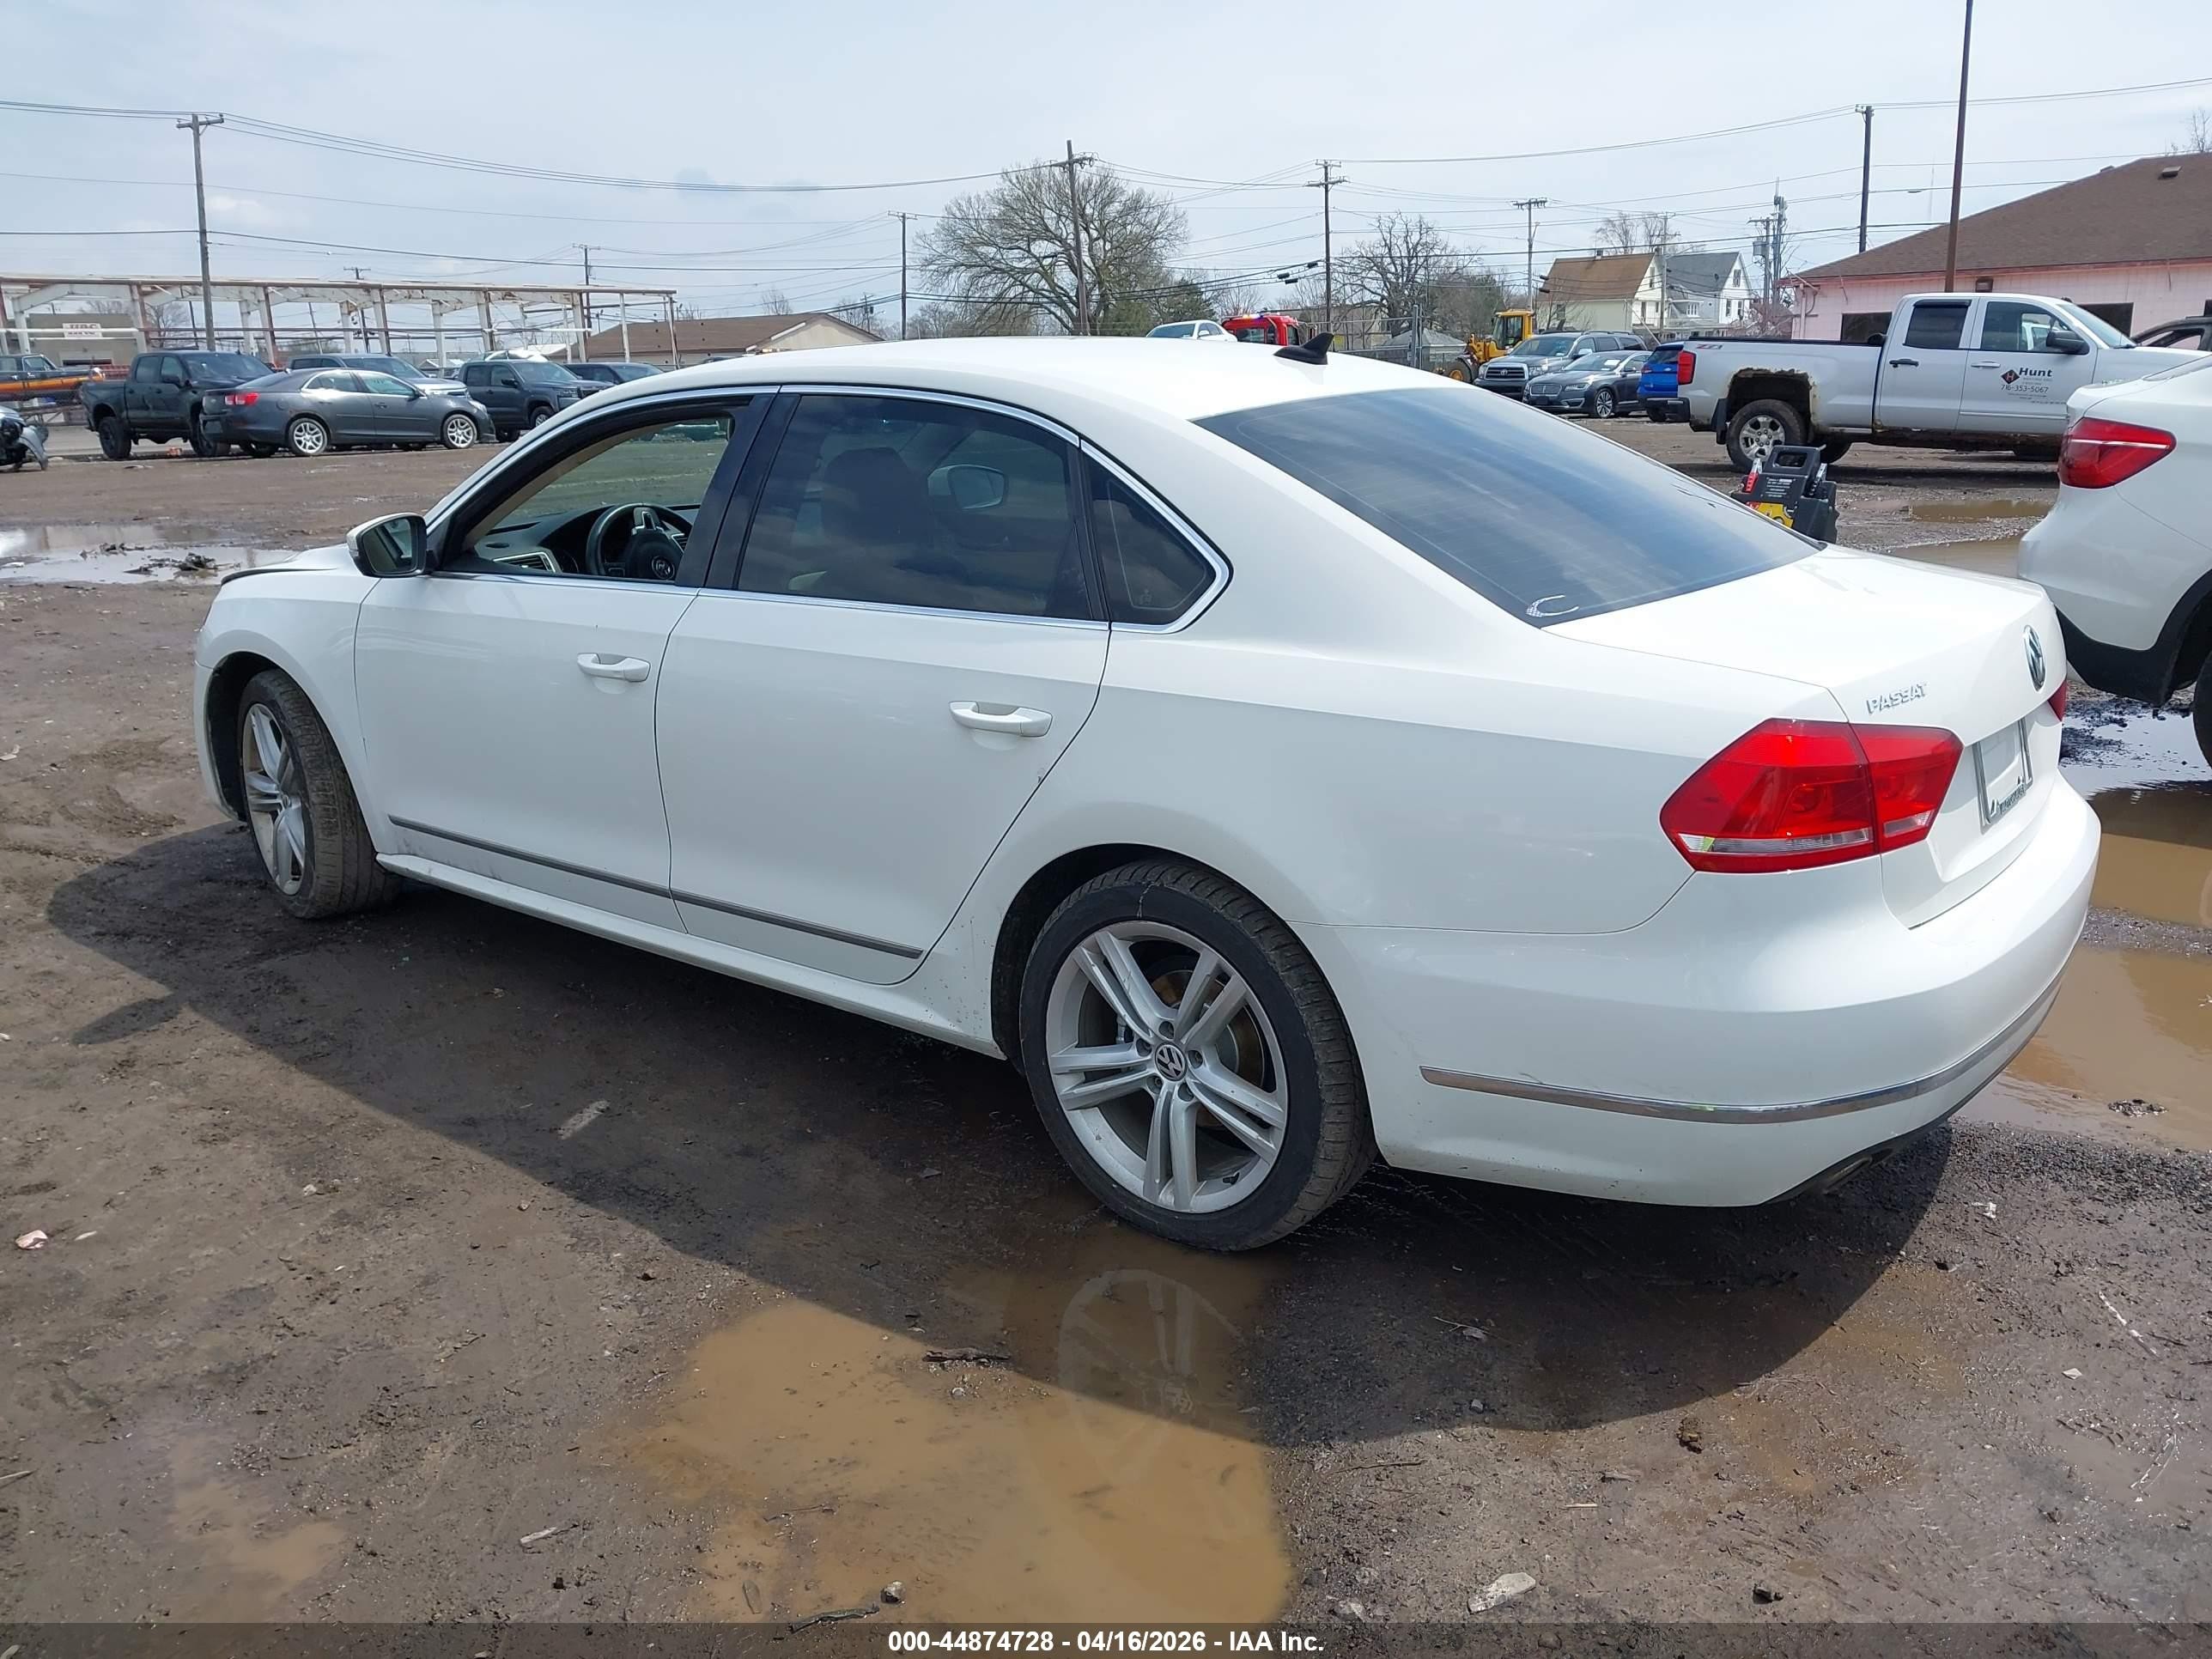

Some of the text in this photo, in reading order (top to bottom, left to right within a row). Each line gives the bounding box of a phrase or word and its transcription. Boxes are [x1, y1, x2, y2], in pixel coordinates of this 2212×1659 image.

[2019, 367, 2052, 377] Hunt
[2001, 384, 2049, 393] 716-353-5067
[1866, 682, 1927, 714] PASSAT
